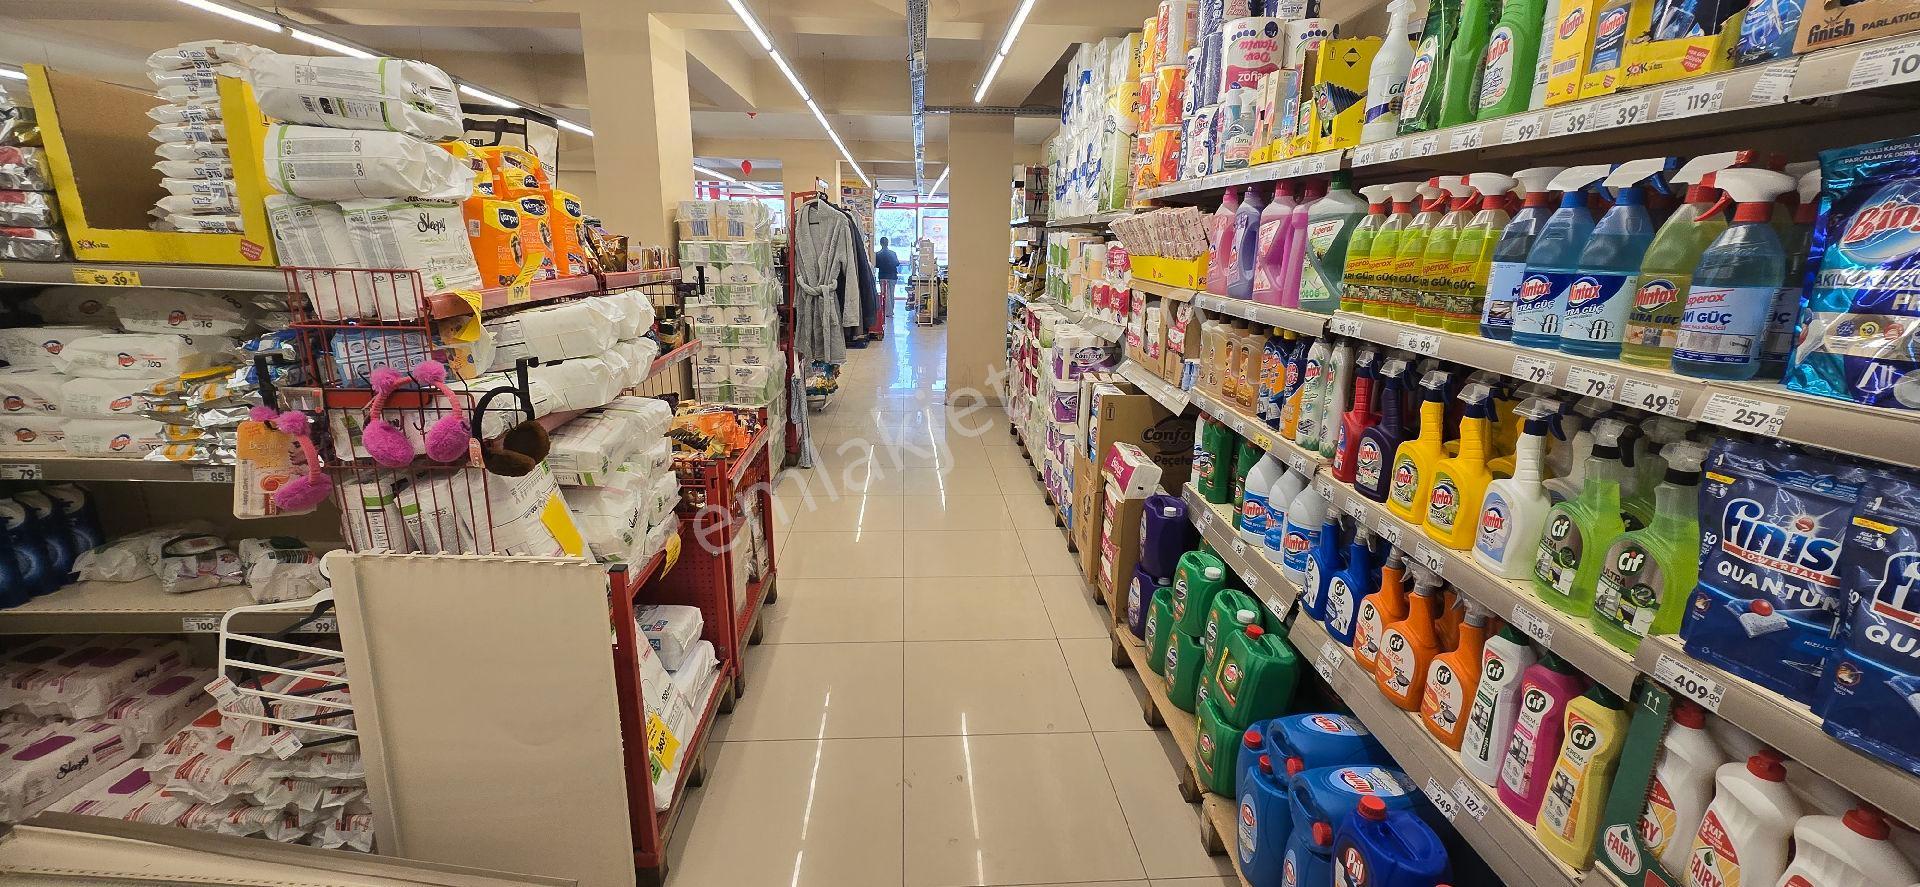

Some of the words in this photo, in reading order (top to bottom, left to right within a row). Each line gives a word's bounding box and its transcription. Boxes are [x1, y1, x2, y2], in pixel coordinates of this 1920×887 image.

[1807, 18, 1854, 45] finish
[417, 212, 446, 235] Sleepy
[112, 275, 127, 286] 39
[1453, 280, 1476, 290] GÜÇ
[1633, 287, 1680, 309] Mintax
[1582, 304, 1605, 315] GÜÇ
[1697, 310, 1733, 326] GÜÇ
[1420, 340, 1431, 352] 99
[19, 469, 35, 480] 79
[1431, 489, 1454, 506] Mintax
[1552, 520, 1569, 537] Cif
[1703, 531, 1718, 545] 50
[1618, 550, 1645, 572] Cif
[1740, 549, 1827, 583] POWERBALL
[195, 622, 213, 631] 100
[315, 622, 330, 632] 99
[1390, 637, 1404, 652] Cif
[1437, 669, 1451, 684] Cif
[1487, 662, 1503, 679] Cif
[1432, 680, 1452, 699] ULTRA
[1526, 693, 1544, 710] Cif
[1572, 729, 1595, 747] Cif
[1607, 832, 1636, 867] FAIRY
[1346, 850, 1365, 880] Pril
